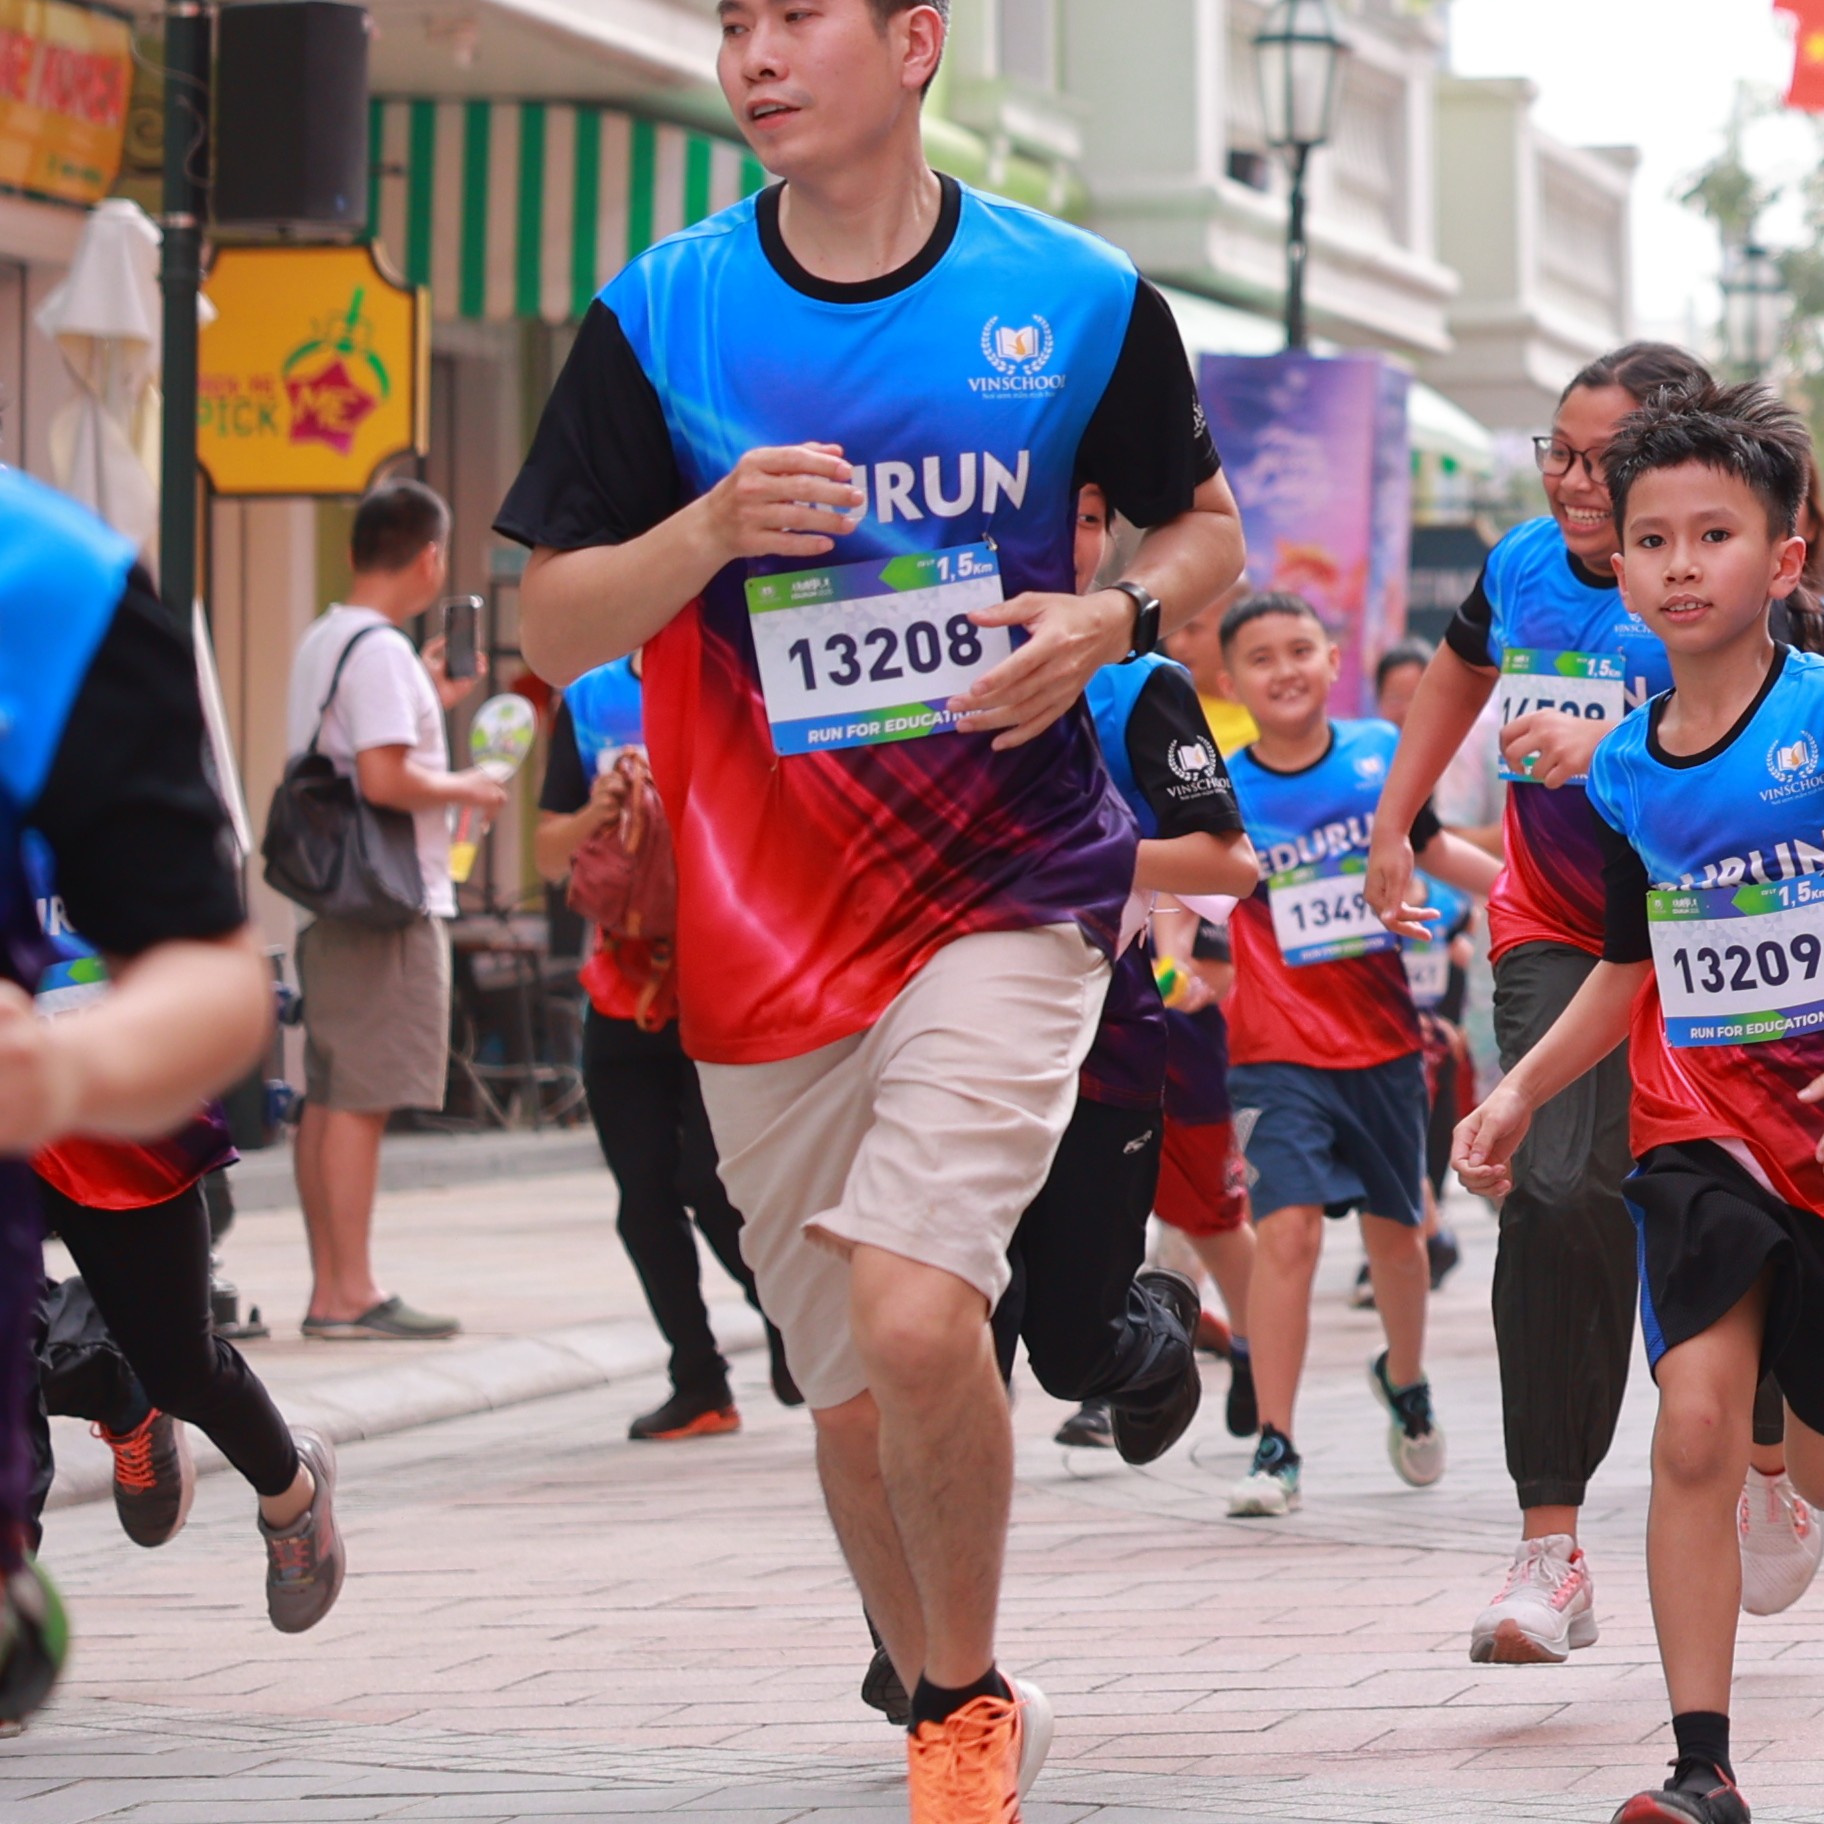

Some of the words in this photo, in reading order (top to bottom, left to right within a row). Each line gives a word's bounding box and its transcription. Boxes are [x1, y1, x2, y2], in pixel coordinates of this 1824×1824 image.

[788, 613, 983, 691] 13208
[807, 724, 845, 744] RUN
[846, 721, 881, 740] FOR
[1258, 812, 1376, 881] EDURU
[1289, 892, 1378, 931] 1349
[1673, 933, 1822, 994] 13209
[1690, 1027, 1715, 1039] RUN
[1717, 1024, 1743, 1038] FOR
